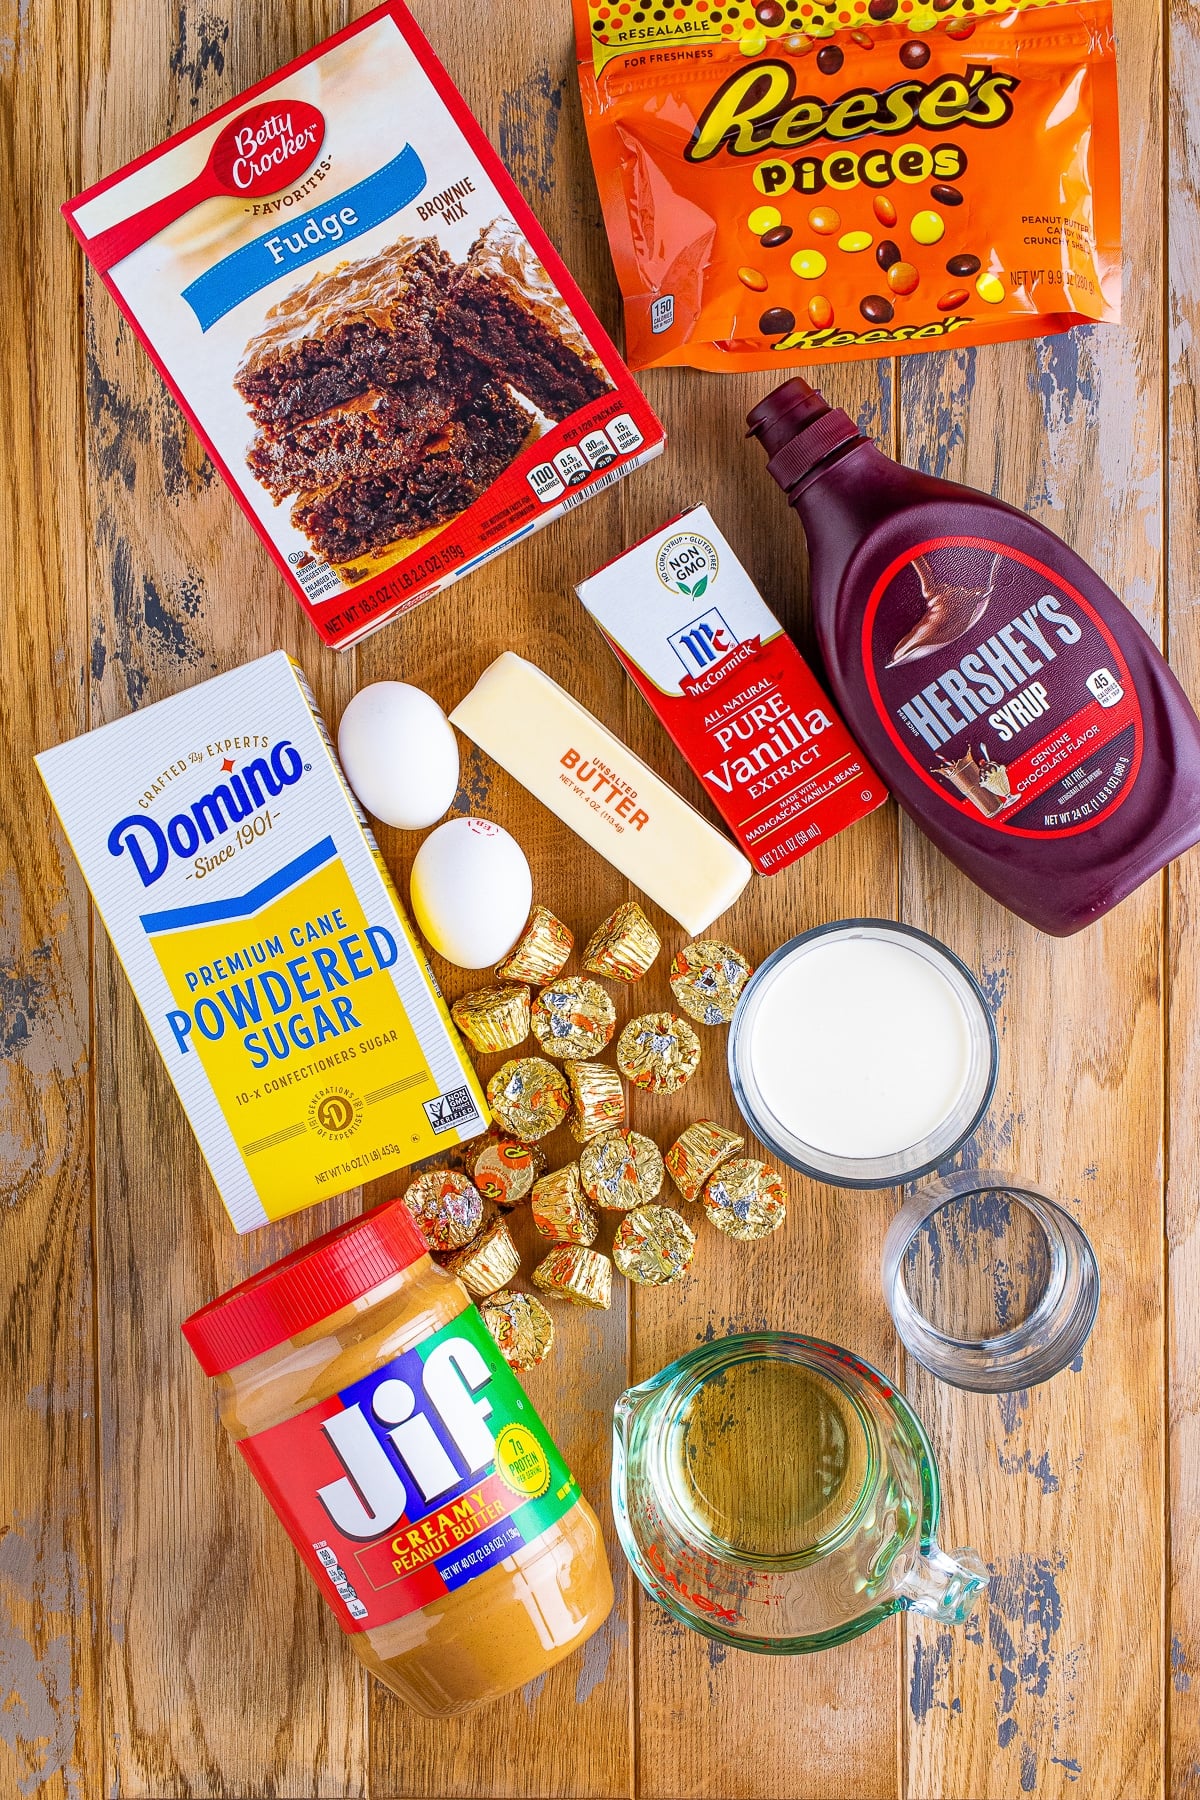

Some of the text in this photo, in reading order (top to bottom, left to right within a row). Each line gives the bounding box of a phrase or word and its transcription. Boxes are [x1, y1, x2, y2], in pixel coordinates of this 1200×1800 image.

[618, 20, 710, 41] RESEALABLE
[624, 49, 713, 68] FOR FRESHNESS
[686, 61, 1018, 162] Reese's
[234, 113, 293, 159] Betty
[232, 128, 317, 189] Crocker
[416, 176, 476, 221] BROWNIE
[441, 201, 468, 226] MIX
[1021, 216, 1089, 233] PEANUT BUTTER
[264, 206, 359, 265] Fudge
[1023, 236, 1070, 247] CRUNCHY
[1010, 270, 1063, 286] NET WT 9.9
[654, 298, 671, 317] 150
[562, 429, 578, 443] PER
[592, 400, 625, 426] PACKAGE
[617, 430, 634, 443] TOTAL
[619, 434, 640, 450] SUGARS
[588, 444, 610, 460] SODIUM
[530, 465, 555, 487] 100
[563, 460, 583, 476] SAT FAT
[536, 477, 561, 496] CALORIES
[658, 536, 683, 583] NO CORN SYRUP
[668, 545, 700, 571] NON
[689, 536, 717, 570] GLUTEN FREE
[296, 561, 317, 578] SERVING
[300, 563, 330, 585] SUGGESTION
[676, 556, 707, 581] GMO
[305, 570, 337, 594] ENLARGED TO
[310, 578, 341, 600] SHOW DETAIL
[324, 615, 345, 636] NET
[342, 605, 360, 624] WT
[358, 593, 379, 614] 18.3
[375, 587, 392, 606] OZ
[390, 581, 400, 598] (1
[399, 573, 413, 592] LB
[411, 565, 427, 583] 2.3
[424, 554, 446, 577] OZ)
[441, 544, 465, 565] 519g
[686, 643, 757, 697] McCormick
[900, 594, 1083, 751] HERSHEY'S
[1093, 673, 1109, 691] 45
[703, 678, 773, 727] ALL NATURAL
[1096, 682, 1118, 700] CALORIES
[713, 692, 791, 753] PURE
[988, 681, 1051, 742] SYRUP
[905, 720, 920, 737] SINCE
[703, 708, 833, 794] Vanilla
[1016, 725, 1100, 792] CHOCOLATE FLAVOR
[1030, 732, 1071, 767] GENUINE
[138, 735, 269, 809] CRAFTED By EXPERTS
[559, 773, 575, 788] NET
[592, 757, 638, 799] UNSALTED
[746, 744, 822, 800] EXTRACT
[1061, 767, 1087, 790] FAT FREE
[1106, 775, 1122, 789] OZ)
[1112, 762, 1126, 777] 680
[560, 747, 650, 832] BUTTER
[779, 781, 818, 808] MADE WITH
[1095, 791, 1108, 804] LB
[1103, 786, 1113, 795] 8
[107, 740, 304, 888] Domino
[745, 763, 861, 842] MADAGASCAR VANILLA BEANS
[1071, 808, 1082, 821] 24
[1080, 803, 1093, 816] OZ
[1089, 798, 1100, 811] (1
[1044, 815, 1058, 826] NET
[1059, 811, 1071, 824] WT
[759, 852, 774, 869] NET
[771, 848, 781, 861] 2
[777, 843, 789, 858] FL
[785, 837, 799, 852] OZ
[794, 830, 809, 847] (59
[184, 908, 347, 993] PREMIUM CANE
[165, 925, 399, 1055] POWDERED
[243, 996, 362, 1069] SUGAR
[263, 1047, 357, 1095] CONFECTIONERS
[359, 1030, 399, 1054] SUGAR
[307, 1086, 354, 1115] GENERATIONS
[447, 1089, 466, 1102] NON
[449, 1095, 469, 1107] GMO
[451, 1101, 471, 1112] Project
[317, 1113, 363, 1141] OF EXPERTISE
[433, 1108, 473, 1126] VERIFIED
[314, 1143, 401, 1185] NET WT 16 OZ (1 LB) 453g
[316, 1337, 496, 1541] Jif
[508, 1438, 525, 1456] 7g
[508, 1452, 539, 1477] PROTEIN
[517, 1473, 527, 1484] PER
[391, 1488, 487, 1556] CREAMY
[391, 1499, 506, 1575] PEANUT BUTTER
[439, 1567, 454, 1582] NET
[450, 1561, 463, 1575] WT
[460, 1557, 470, 1569] 40
[467, 1552, 479, 1565] OZ
[475, 1549, 485, 1563] (2
[481, 1544, 492, 1557] LB
[488, 1541, 496, 1552] 8
[492, 1536, 506, 1548] OZ)
